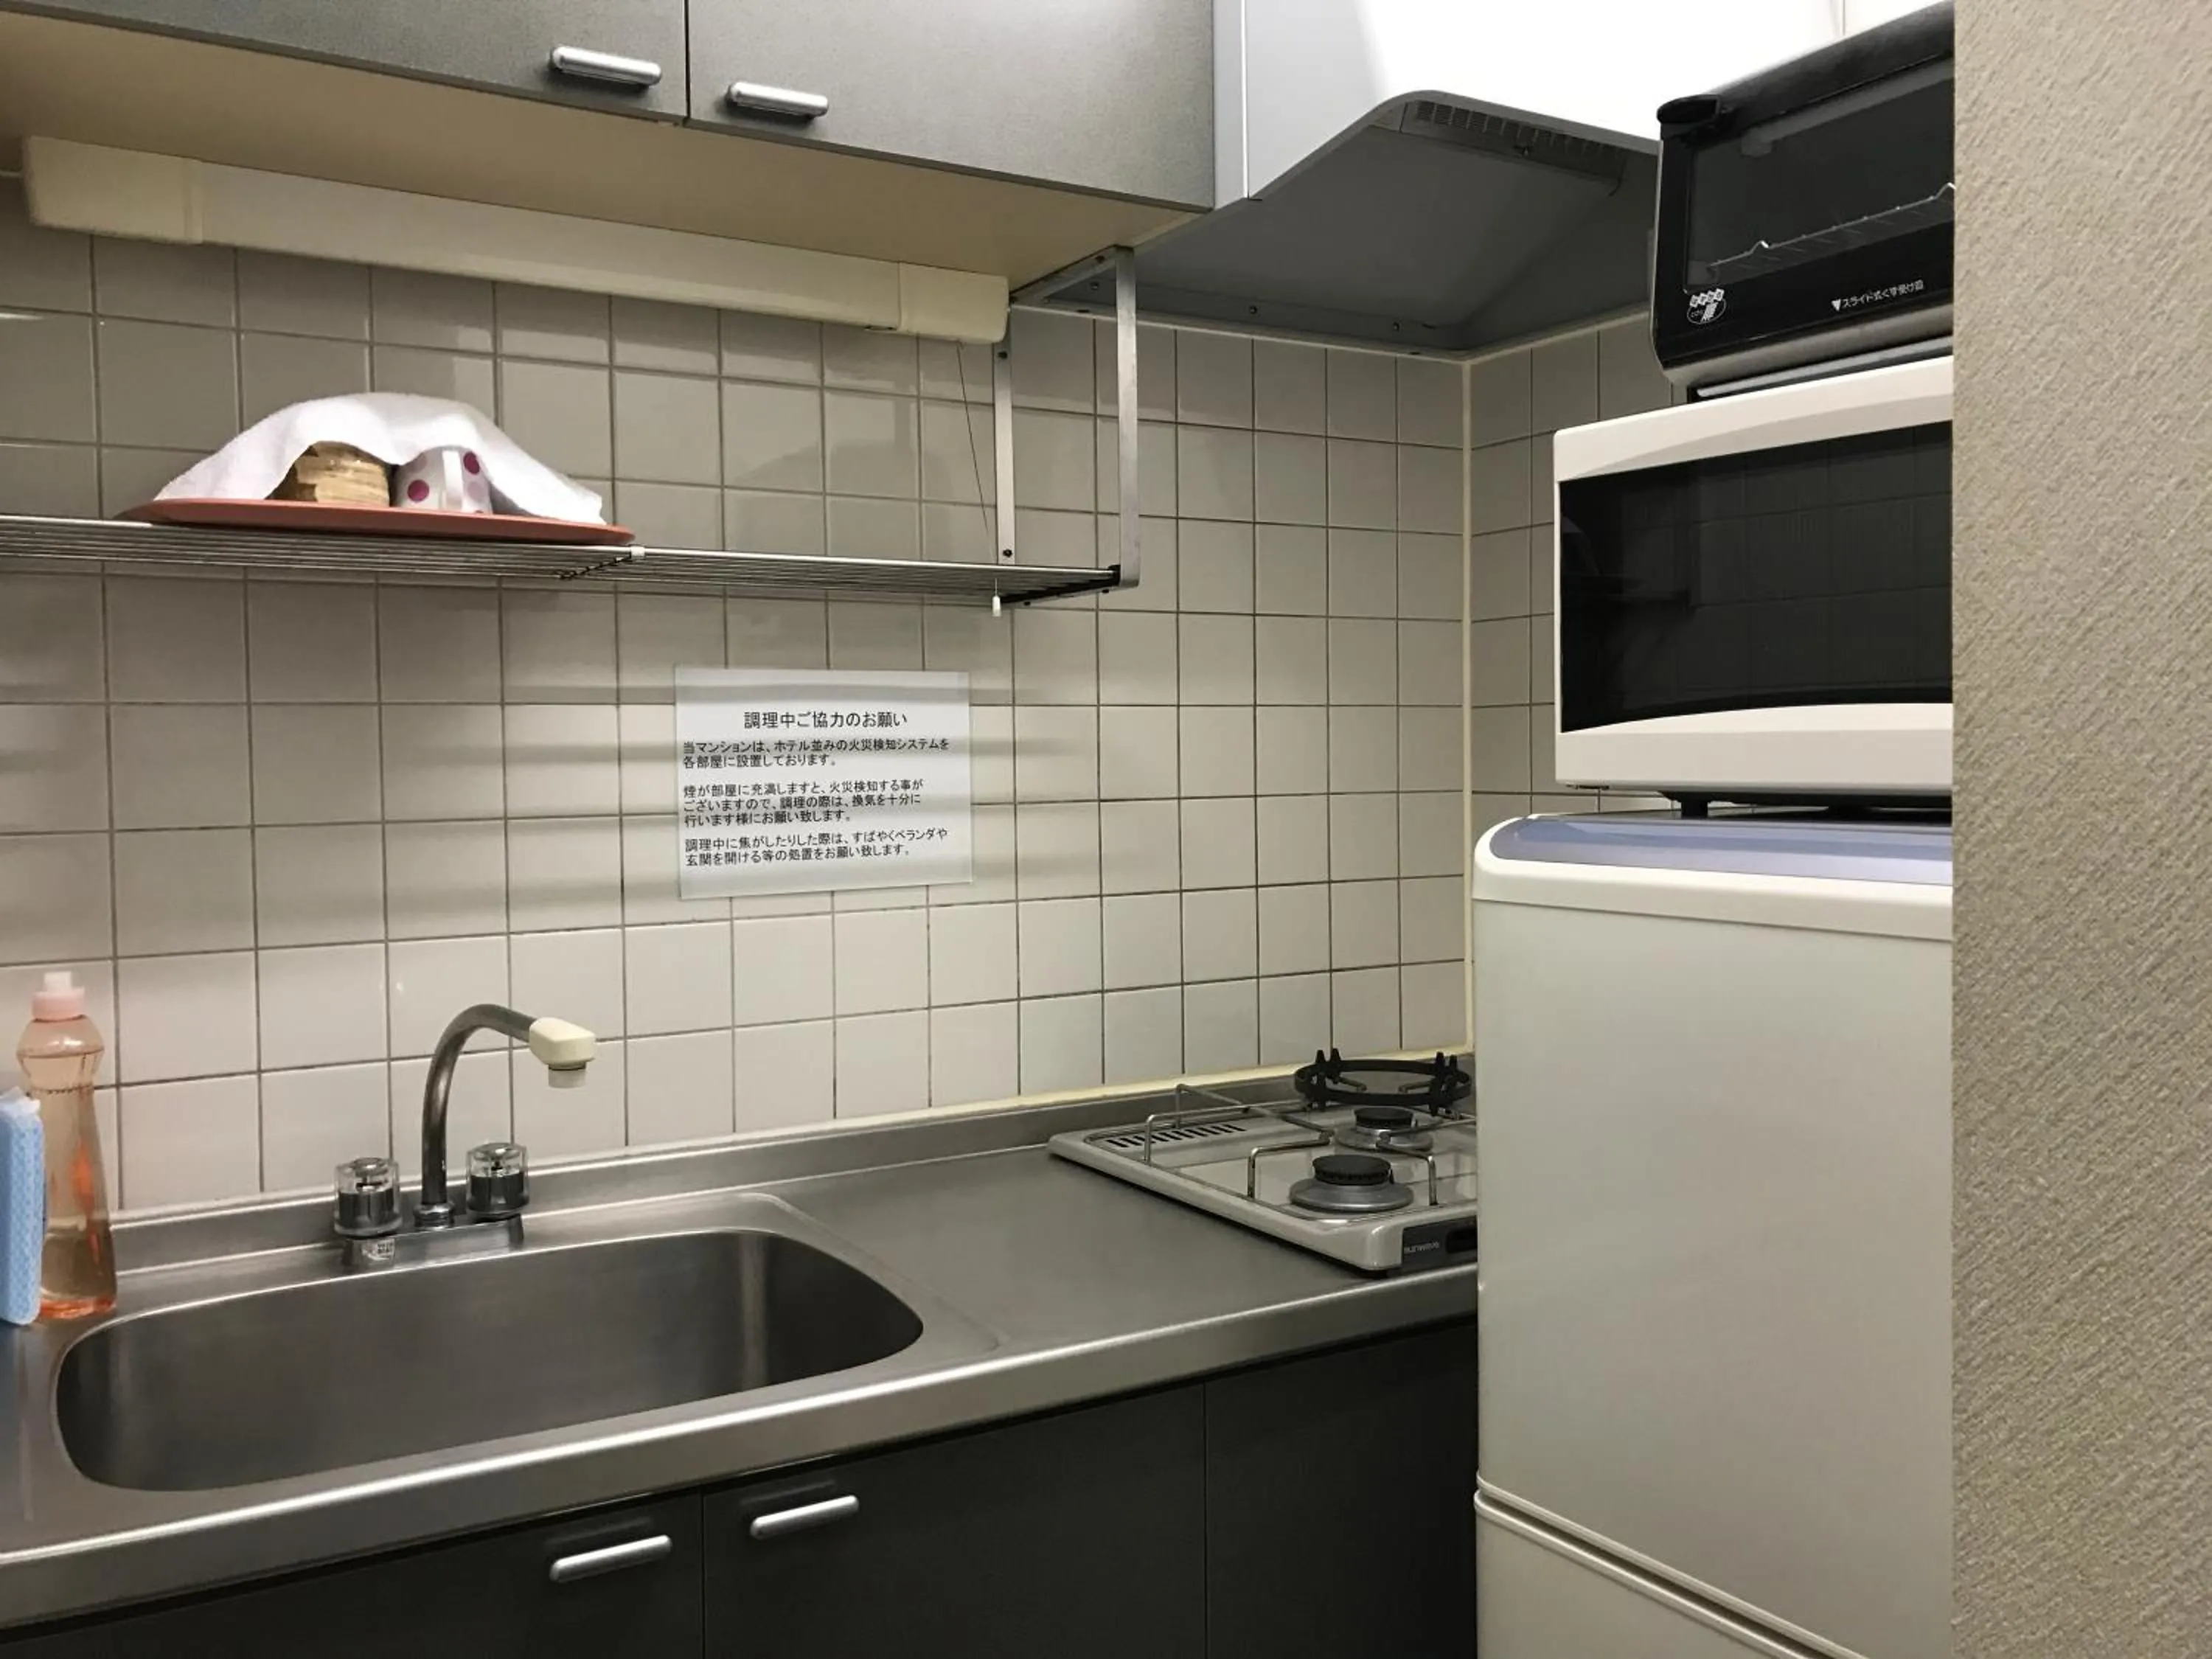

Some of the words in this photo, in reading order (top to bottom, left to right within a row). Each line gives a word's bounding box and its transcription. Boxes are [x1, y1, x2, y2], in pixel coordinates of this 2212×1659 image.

[743, 711, 908, 728] 調理中ご協力のお願い
[684, 738, 950, 754] 当マンションは、ホテル並みの火災検知システムを
[684, 754, 836, 769] 各部屋に設置しております。
[684, 779, 924, 798] 煙が部屋に充満しますと、火災検知する事が
[684, 793, 921, 812] ございますので、調理の際は、換気を十分に
[684, 810, 850, 828] 行います様にお願い致します。
[685, 827, 947, 852] 調理中に焦がしたりした際は、すばやくベランダや
[686, 844, 909, 866] 玄関を開ける等の処置をお願い致します。
